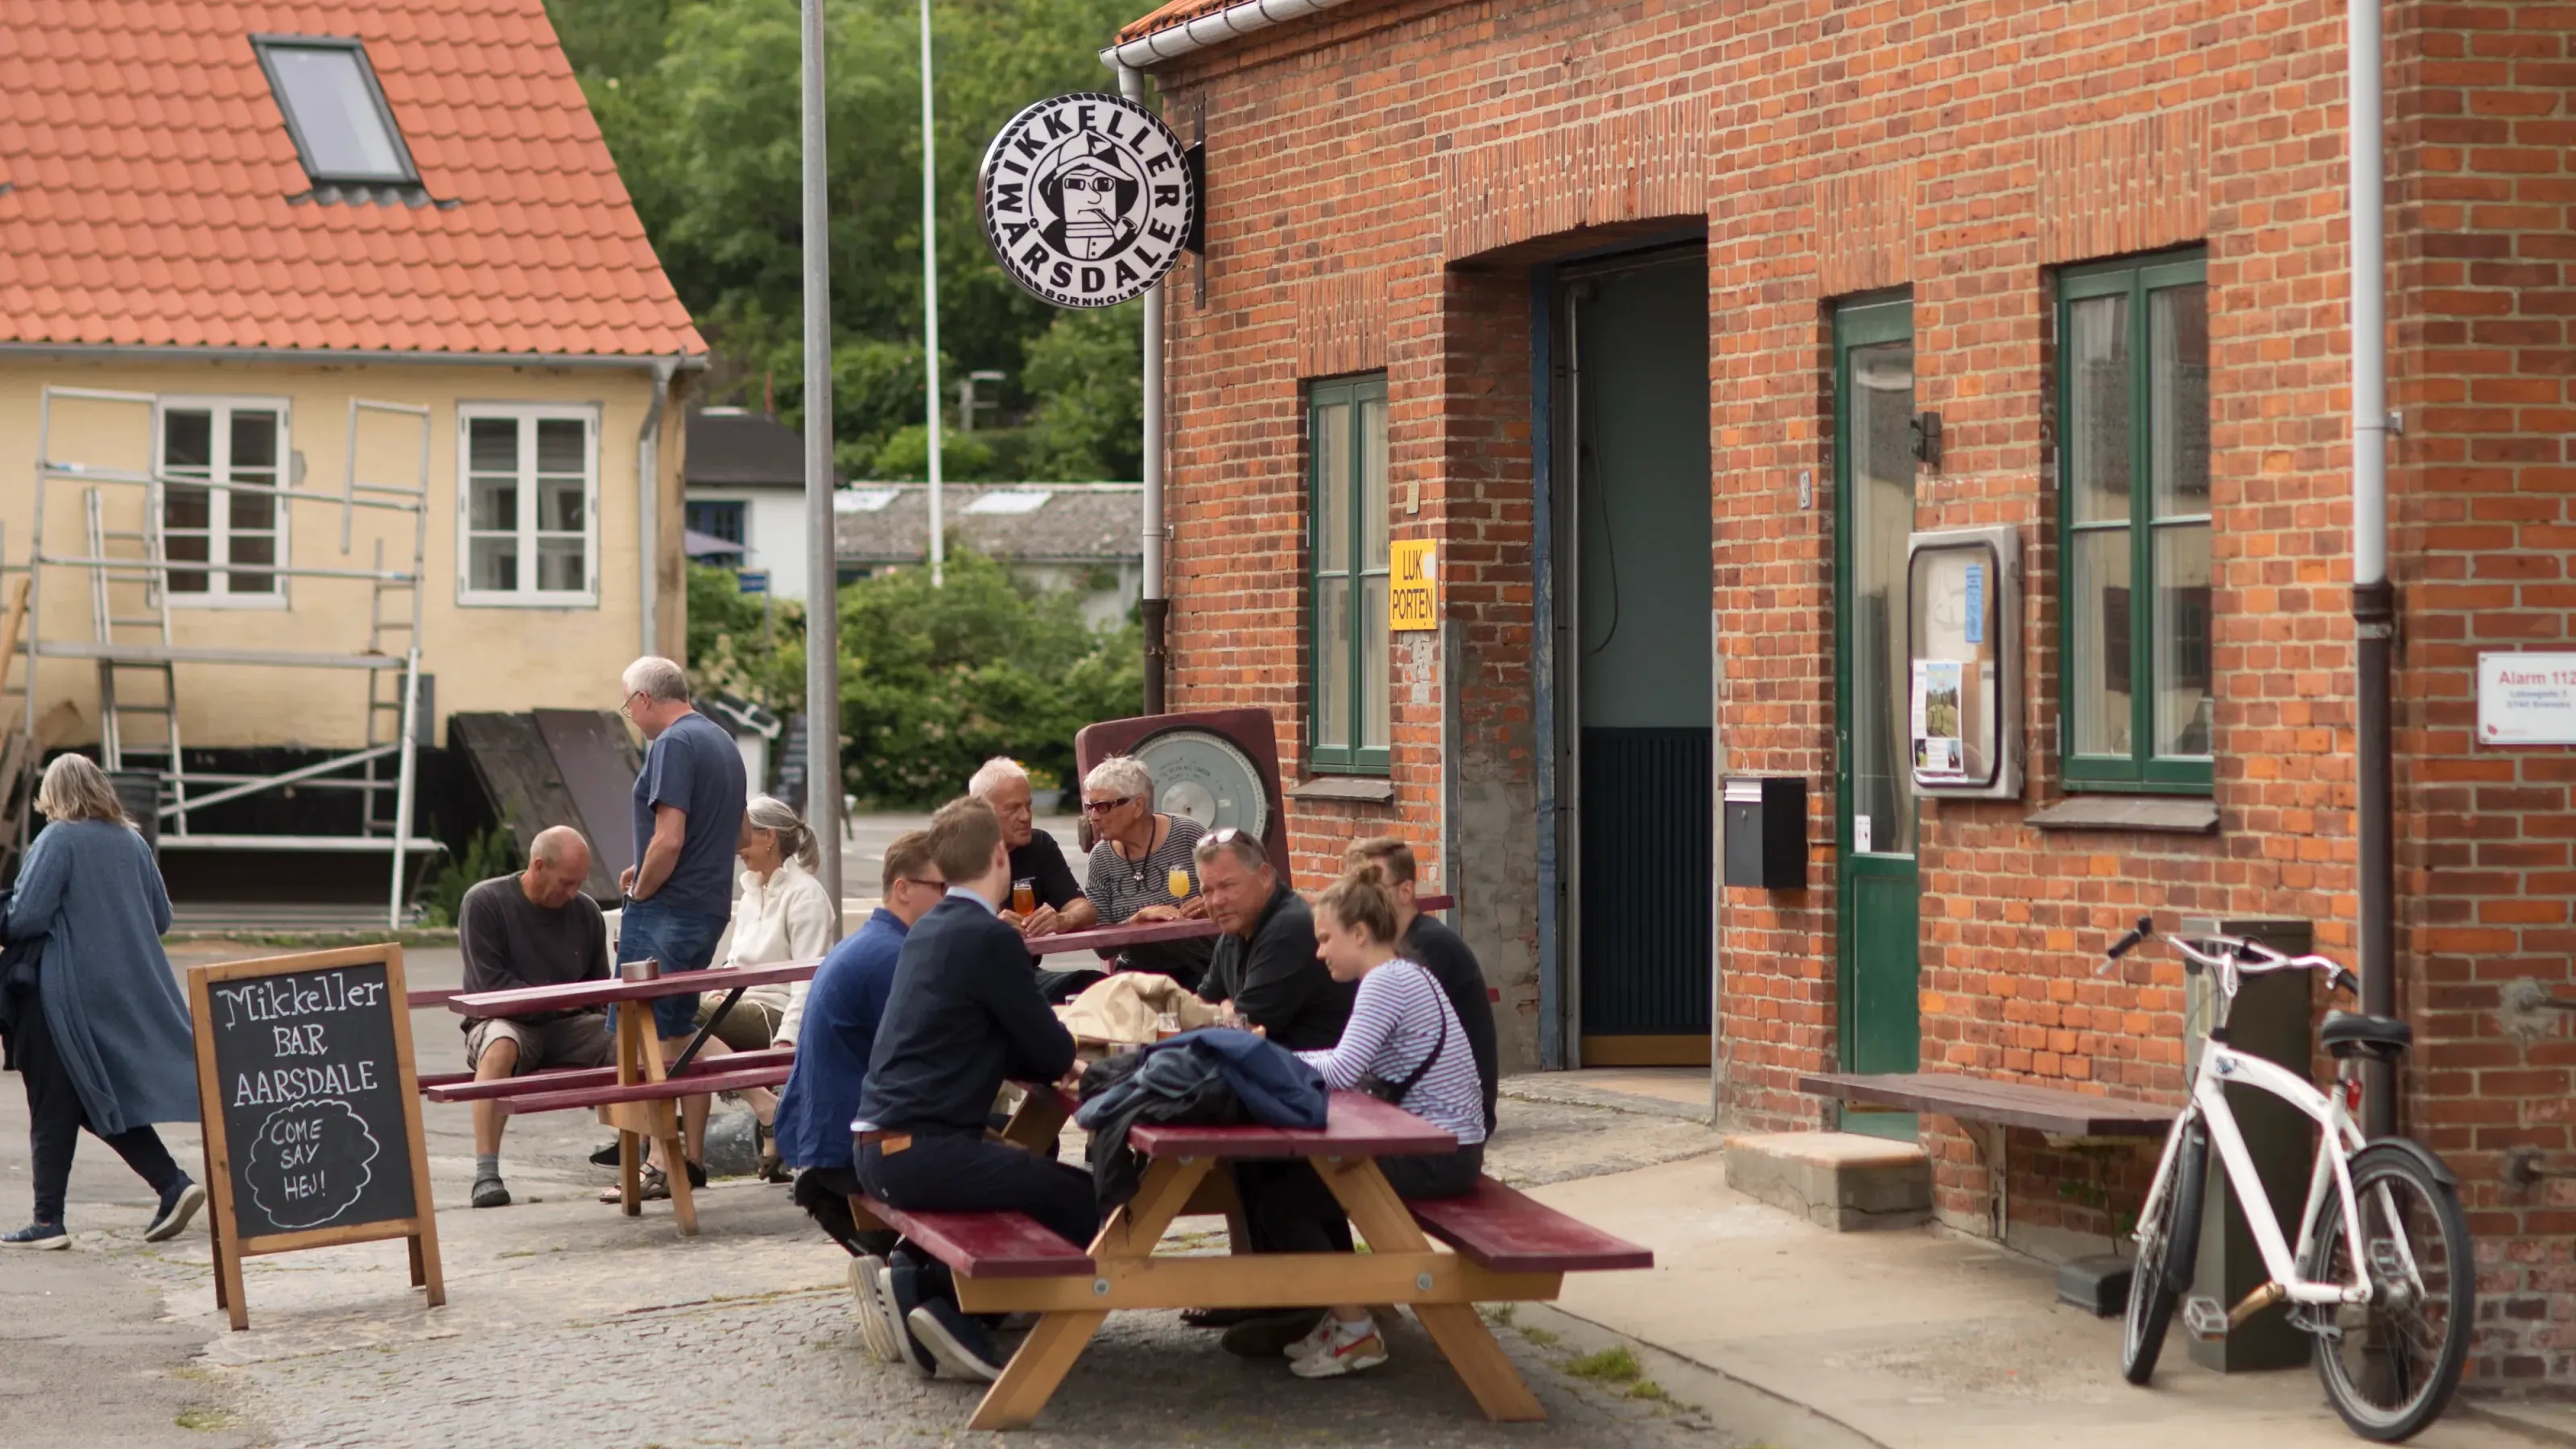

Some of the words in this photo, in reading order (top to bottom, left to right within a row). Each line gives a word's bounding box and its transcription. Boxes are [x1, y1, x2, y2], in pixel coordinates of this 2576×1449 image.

[997, 105, 1180, 213] MIKKELLER
[1044, 286, 1141, 307] BORNHOLM
[1403, 549, 1422, 580] LUK
[1393, 588, 1433, 619] PORTEN
[2499, 671, 2546, 684] Alarm
[2552, 671, 2576, 685] 112
[216, 972, 384, 1030] Mikkeller
[272, 1024, 328, 1058] BAR
[233, 1060, 378, 1107] AARSDALE
[270, 1118, 324, 1146] COME
[280, 1143, 320, 1170] SAY
[283, 1170, 326, 1203] HEJ!
